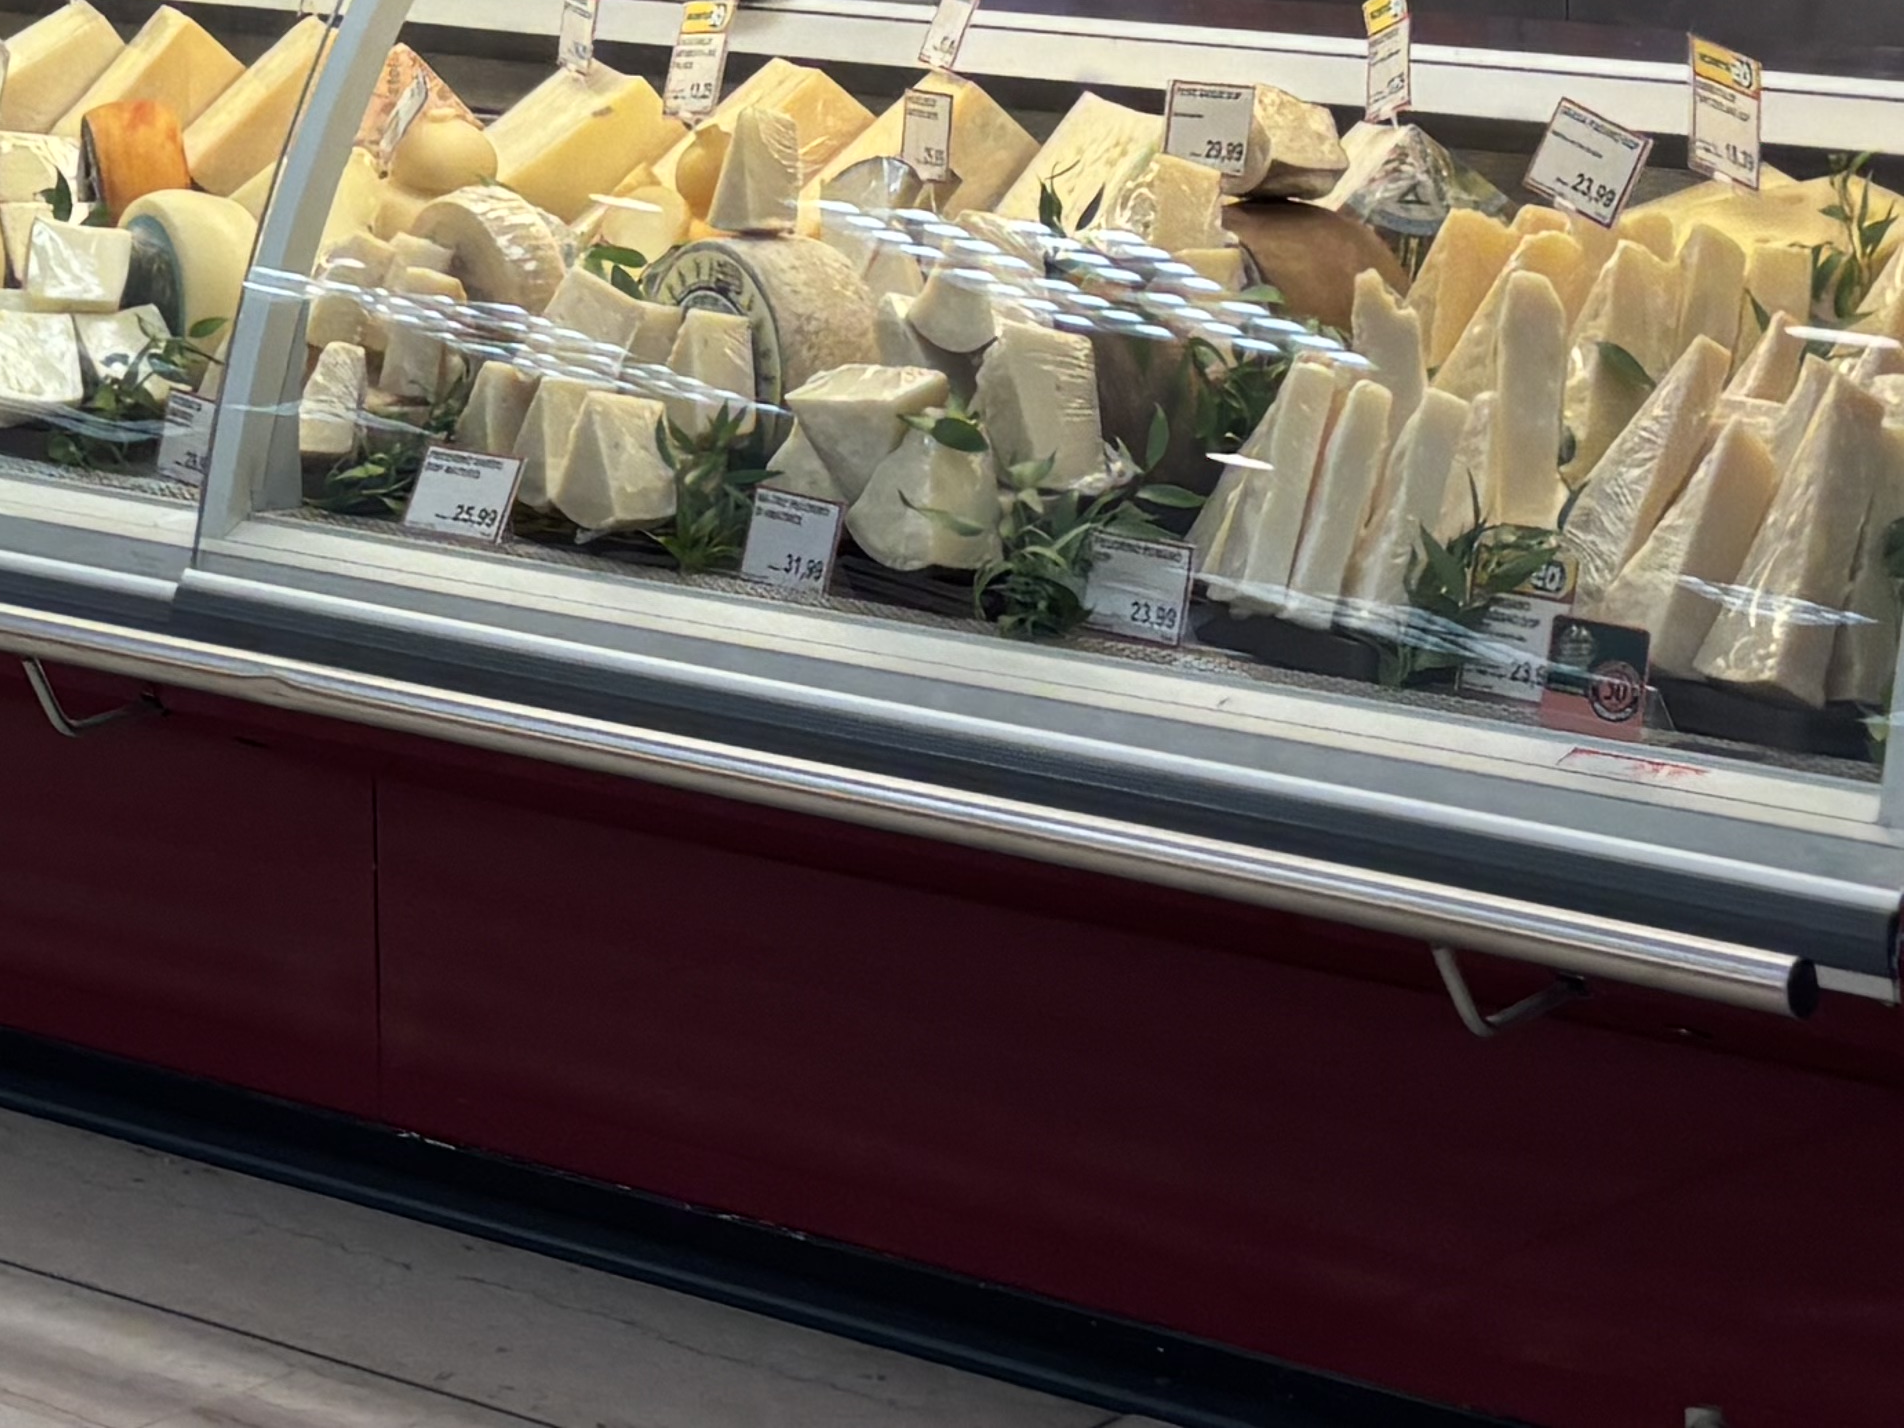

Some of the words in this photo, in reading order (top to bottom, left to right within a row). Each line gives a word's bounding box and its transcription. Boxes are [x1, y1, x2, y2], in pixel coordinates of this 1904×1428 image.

[1571, 172, 1616, 208] 23,99
[455, 503, 498, 528] 25,99
[1130, 600, 1178, 630] 23,99
